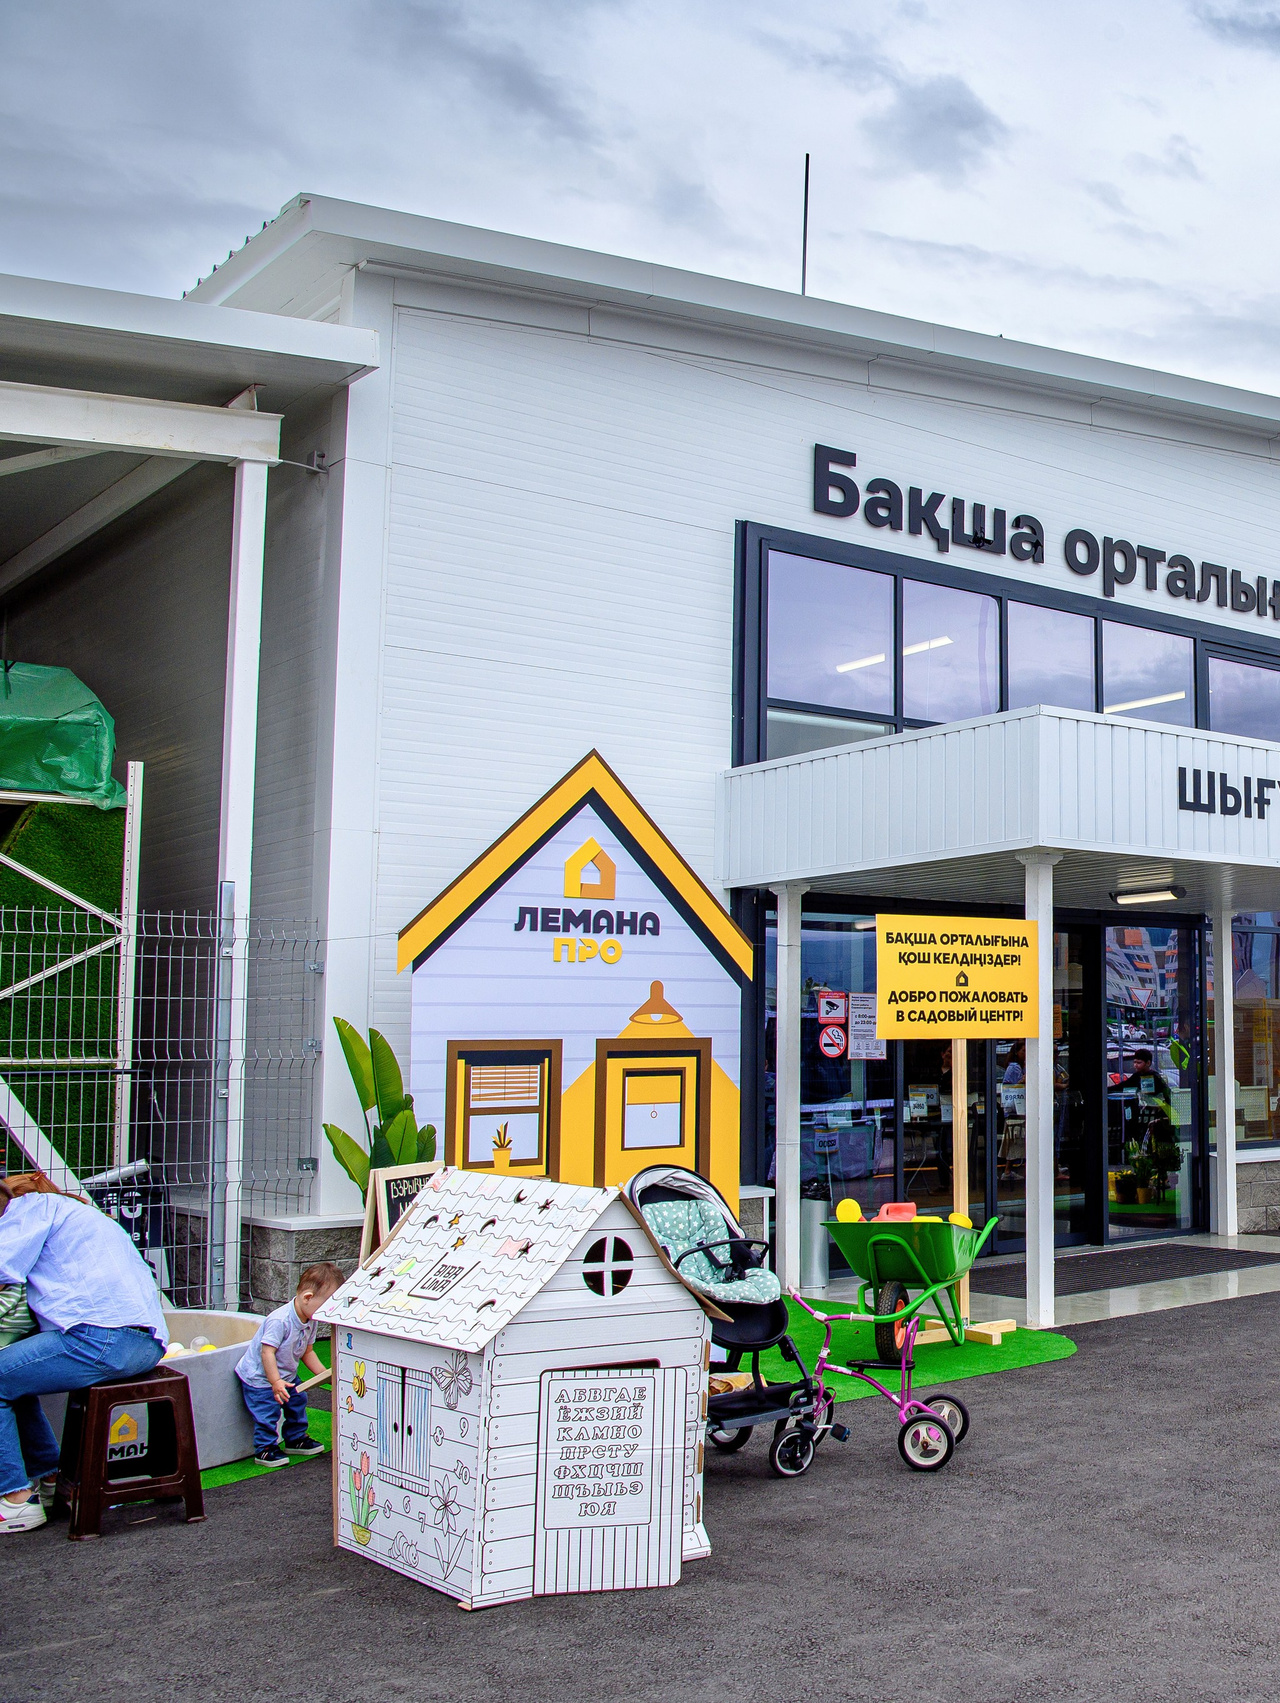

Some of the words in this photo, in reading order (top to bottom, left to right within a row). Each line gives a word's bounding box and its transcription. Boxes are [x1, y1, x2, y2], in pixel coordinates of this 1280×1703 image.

[812, 442, 1046, 564] Бақша
[514, 906, 661, 936] ЛЕМАНА
[886, 932, 937, 947] БАҚША
[940, 933, 1029, 948] ОРТАЛЫҒЫНА
[553, 937, 623, 964] ПРО
[898, 952, 931, 966] ҚОШ
[934, 952, 1021, 968] КЕЛДІҢІЗДЕР!
[888, 990, 936, 1004] ДОБРО
[940, 990, 1028, 1003] ПОЖАЛОВАТЬ
[896, 1010, 904, 1022] В
[907, 1007, 977, 1024] САДОВЫЙ
[980, 1010, 1023, 1024] ЦЕНТР!
[434, 1264, 464, 1280] BIBA
[420, 1277, 452, 1292] LINA
[433, 1426, 444, 1446] 8
[460, 1417, 469, 1438] 9
[351, 1432, 358, 1451] 3
[454, 1459, 470, 1485] 10
[382, 1499, 392, 1518] 5
[402, 1495, 411, 1513] 6
[578, 1501, 616, 1516] ЮЯ
[418, 1511, 426, 1533] 7
